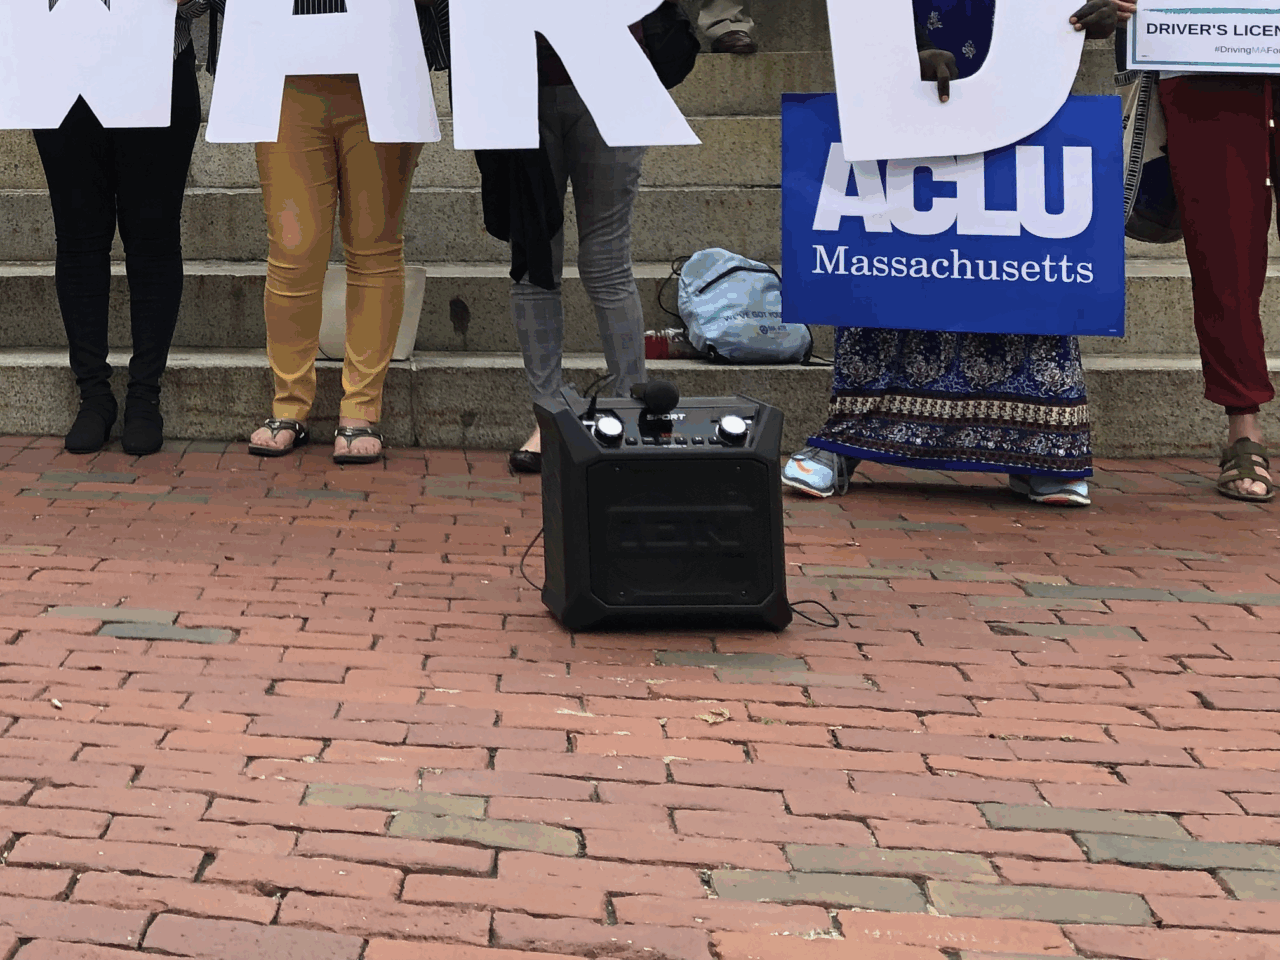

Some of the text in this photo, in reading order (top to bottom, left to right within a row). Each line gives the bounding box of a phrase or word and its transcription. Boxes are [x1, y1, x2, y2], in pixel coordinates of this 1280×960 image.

[1146, 23, 1228, 36] DRIVER'S
[812, 142, 1092, 239] ACLU
[812, 245, 1094, 284] Massachusetts
[646, 413, 687, 421] SPORT
